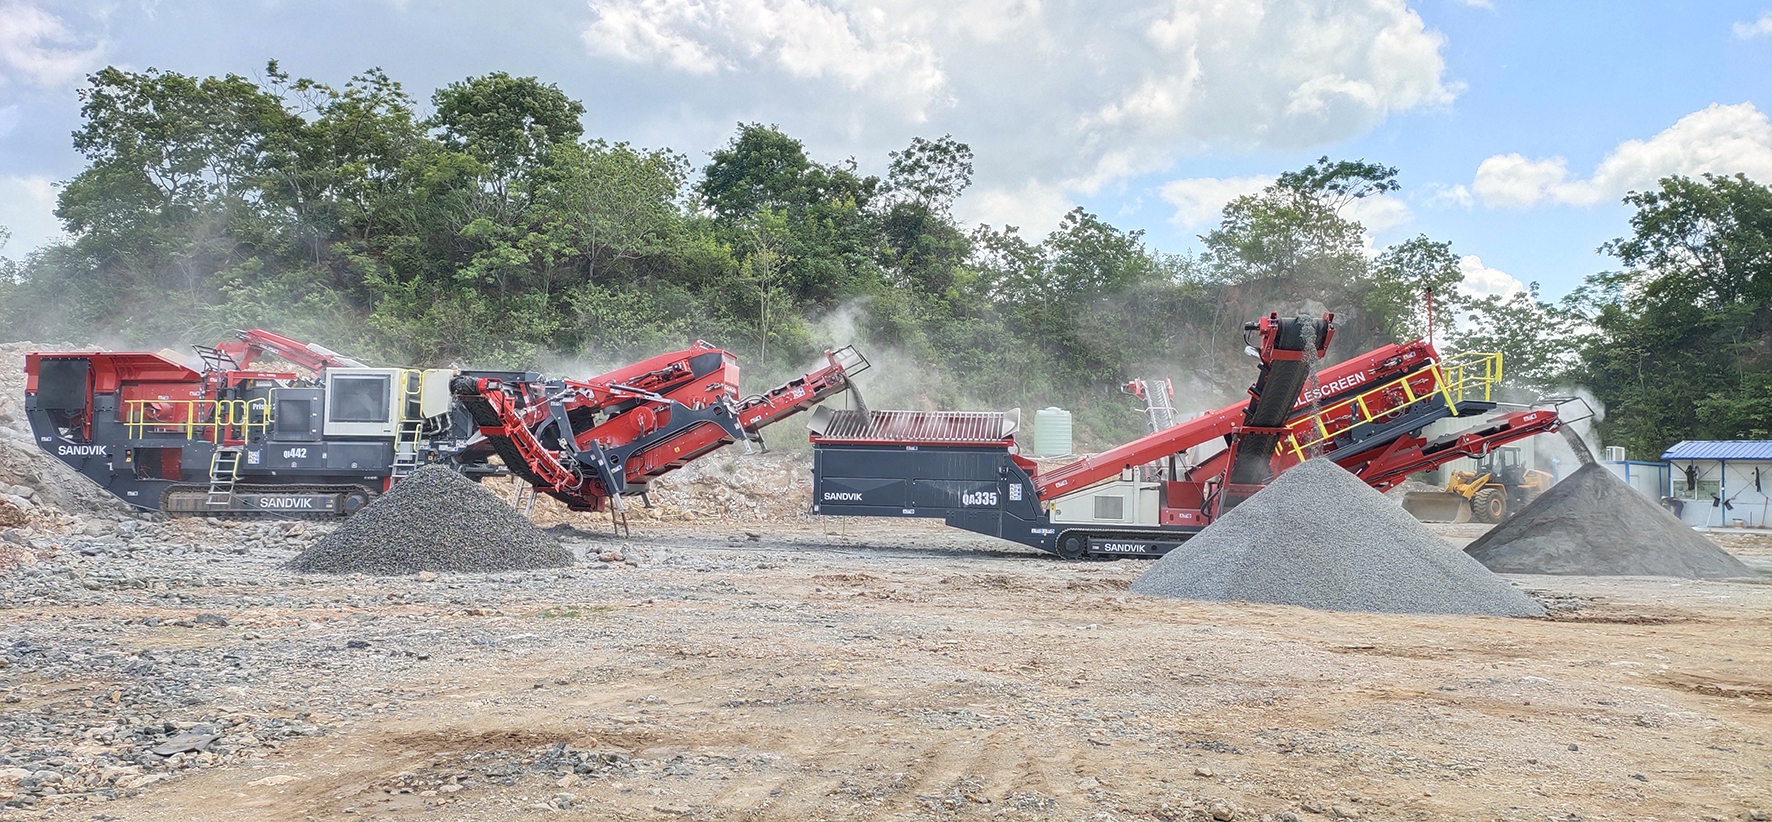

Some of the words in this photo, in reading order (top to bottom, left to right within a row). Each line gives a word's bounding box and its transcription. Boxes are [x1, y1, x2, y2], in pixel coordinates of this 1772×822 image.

[58, 445, 107, 456] SANDVIK
[823, 492, 863, 501] SANDVIK
[962, 491, 997, 506] QA335
[260, 497, 313, 509] SANDVIK
[1104, 543, 1146, 553] SANDVIK
